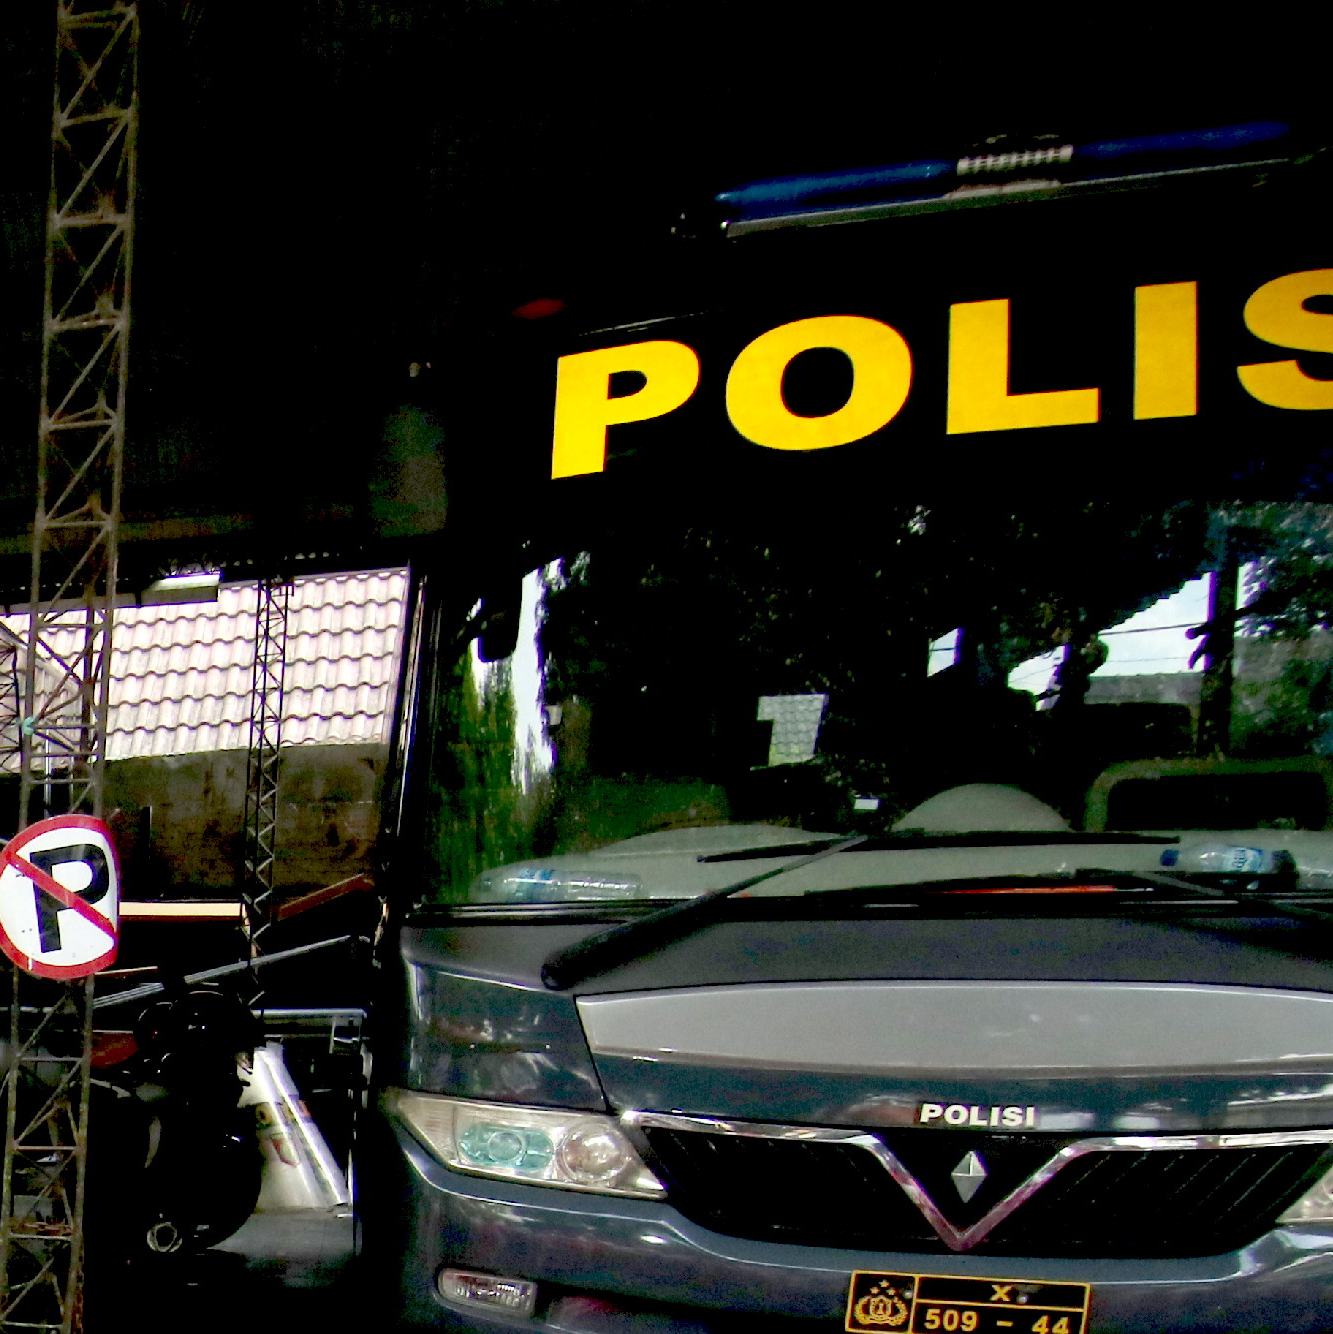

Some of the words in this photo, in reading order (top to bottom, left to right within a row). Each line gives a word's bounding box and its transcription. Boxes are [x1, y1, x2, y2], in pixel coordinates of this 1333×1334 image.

[551, 268, 1333, 479] POLIS
[30, 843, 109, 954] P
[919, 1102, 1036, 1127] POLISI
[990, 1284, 1013, 1302] X
[924, 1308, 980, 1332] 509
